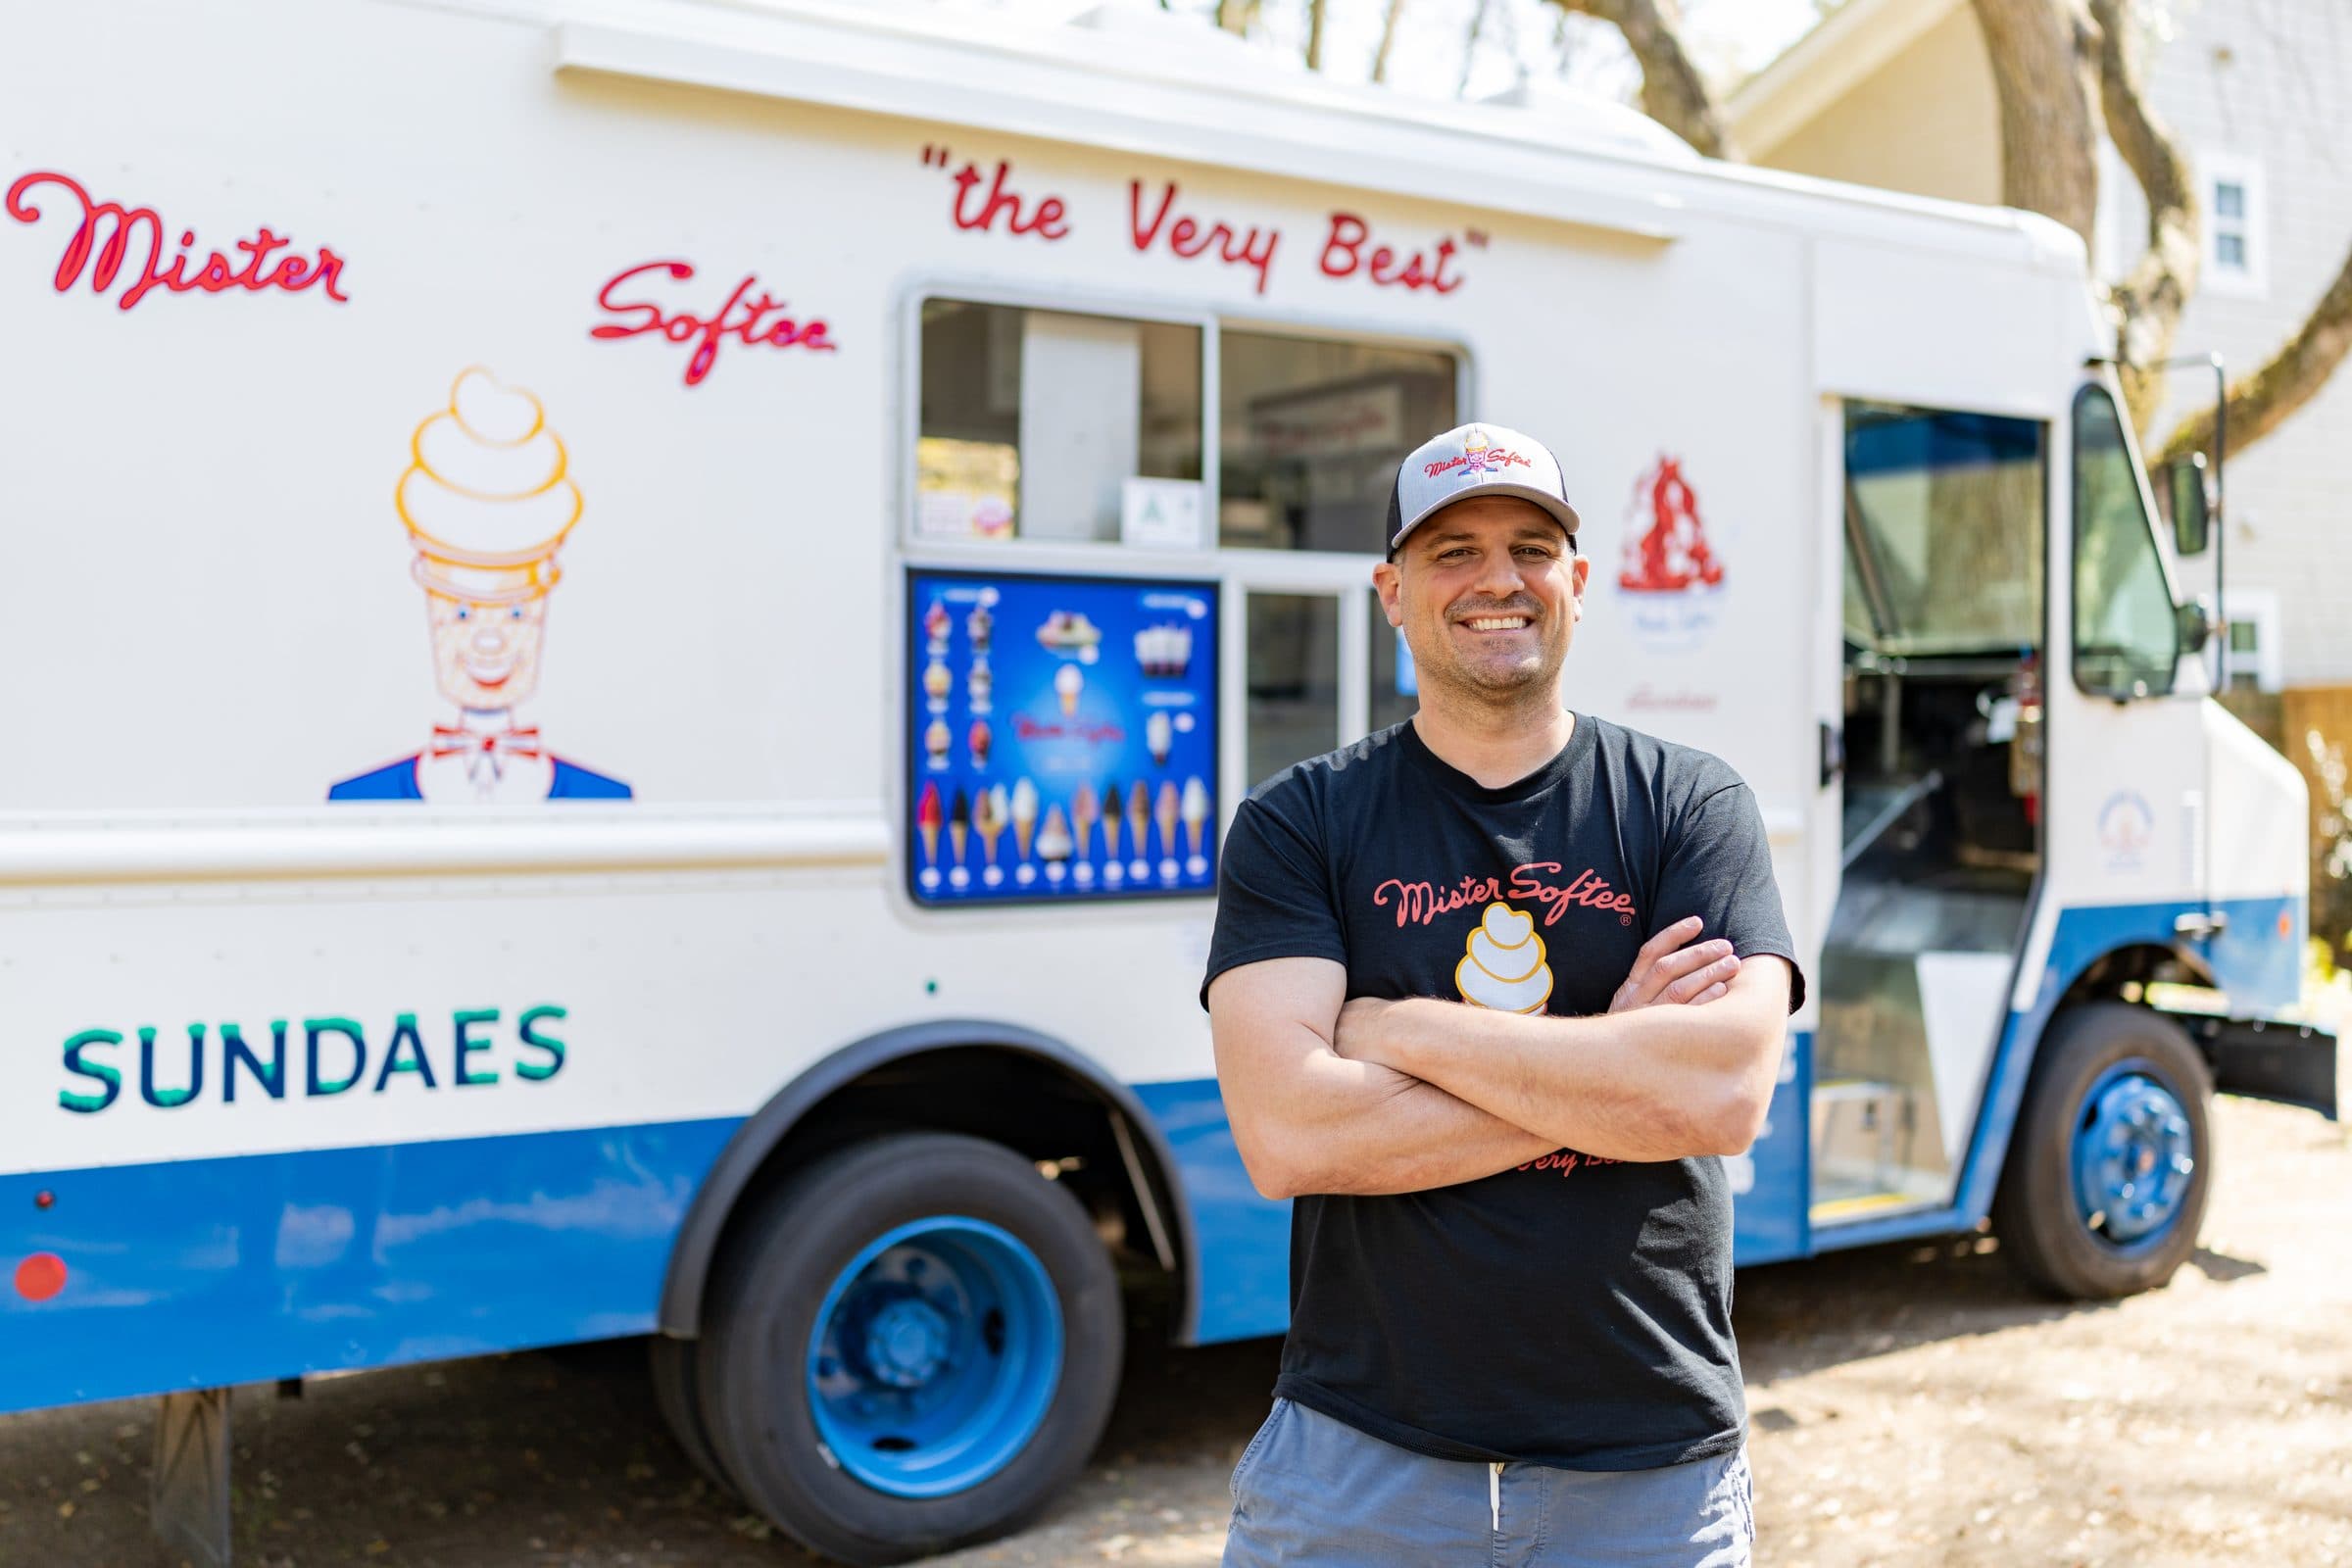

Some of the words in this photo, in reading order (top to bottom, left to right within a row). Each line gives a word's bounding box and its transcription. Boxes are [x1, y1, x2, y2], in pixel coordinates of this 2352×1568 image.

[4, 171, 350, 311] Mister
[590, 261, 839, 387] Softee
[1127, 178, 1280, 295] Very
[1424, 456, 1468, 479] Mister
[1373, 876, 1503, 928] Mister
[1506, 861, 1637, 927] Softee
[58, 1005, 568, 1114] SUNDAES
